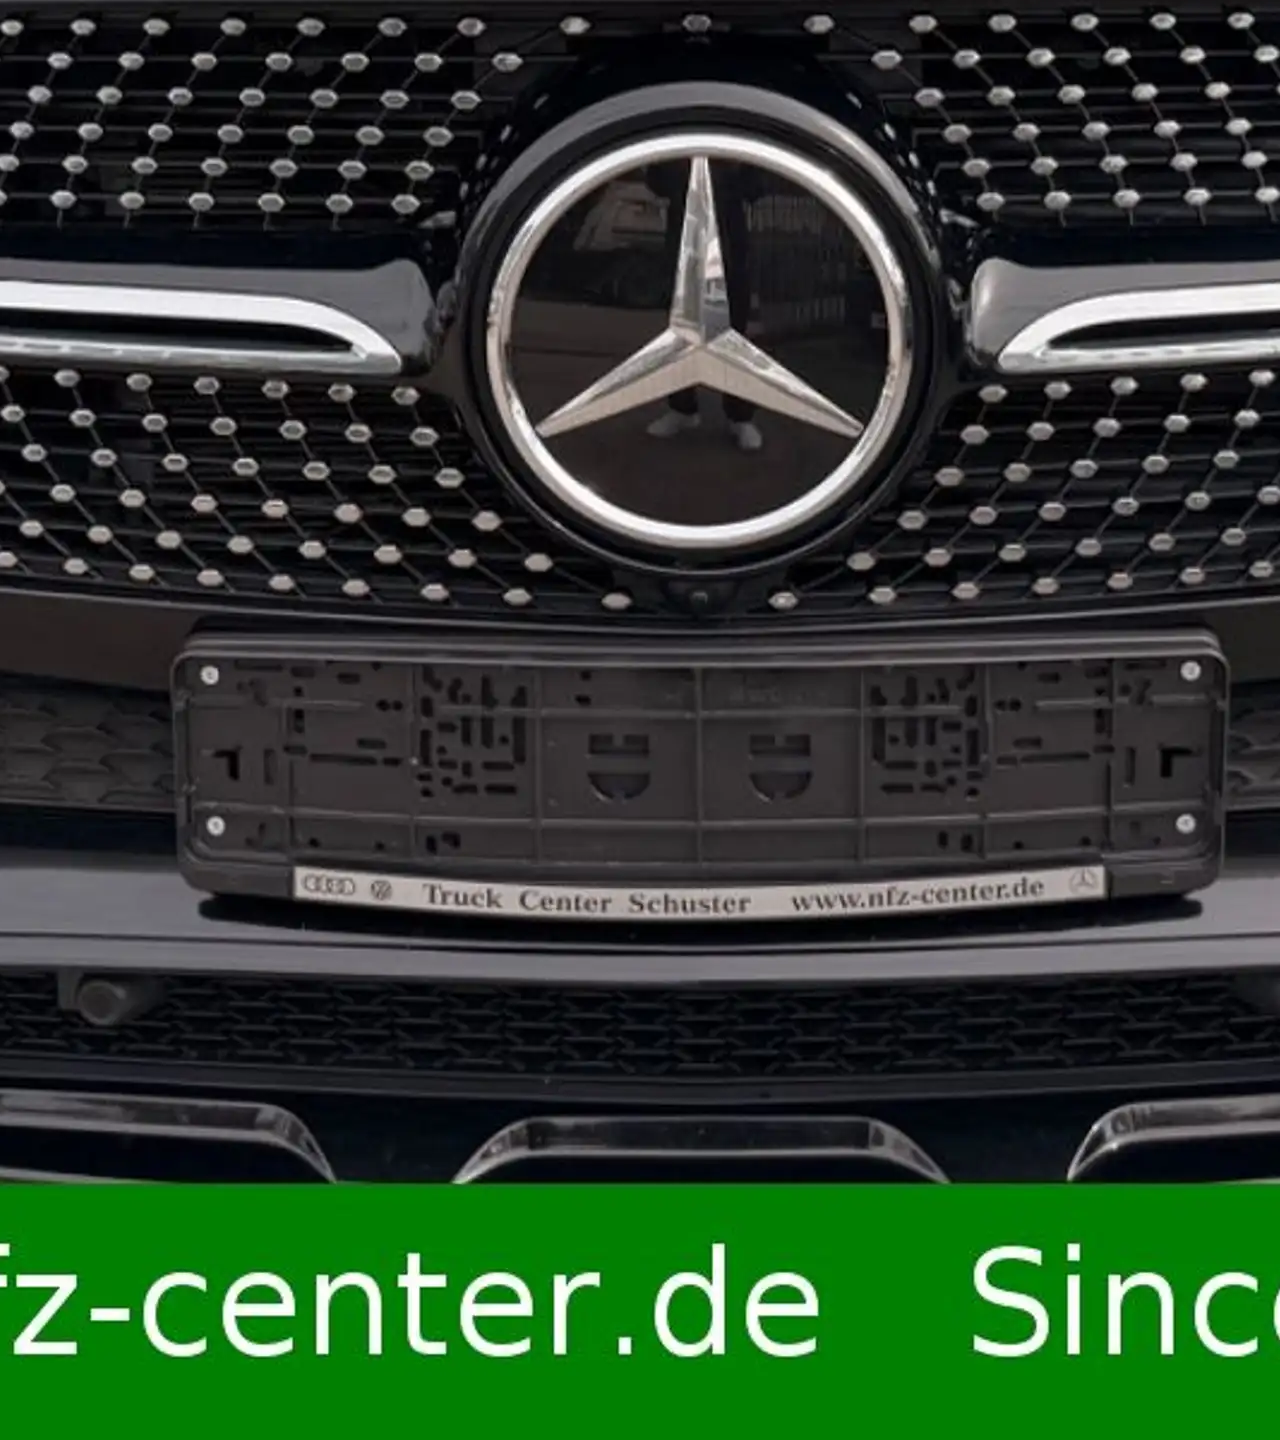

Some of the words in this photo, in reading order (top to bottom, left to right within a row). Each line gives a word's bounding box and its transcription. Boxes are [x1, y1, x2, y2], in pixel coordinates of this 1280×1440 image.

[422, 883, 503, 909] Truck
[519, 889, 612, 914] Center
[628, 892, 752, 915] Schuster
[792, 876, 1045, 912] www.nfz-center.de
